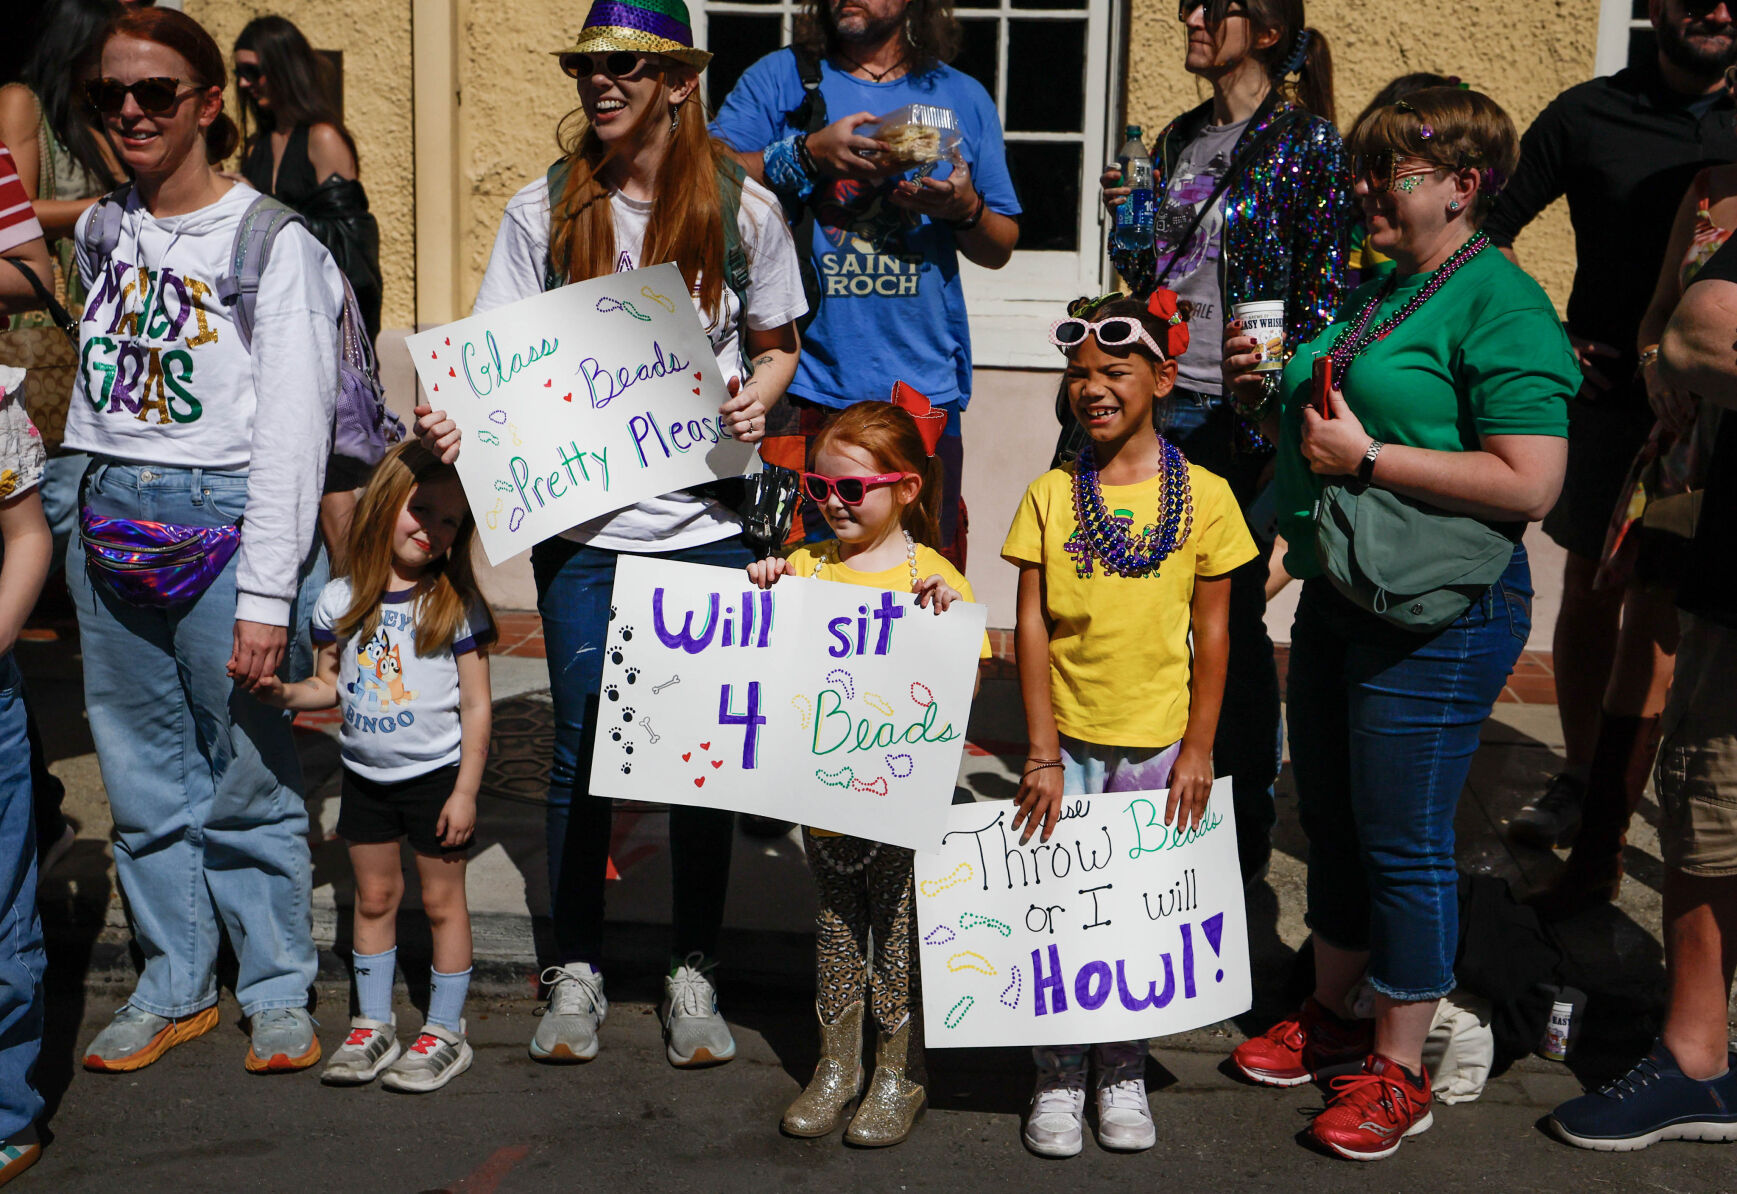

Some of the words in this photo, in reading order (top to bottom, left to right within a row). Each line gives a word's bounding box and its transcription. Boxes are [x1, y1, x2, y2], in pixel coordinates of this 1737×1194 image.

[83, 260, 218, 349] MARDI
[826, 275, 919, 295] ROCH
[81, 336, 203, 424] GRAS
[462, 330, 559, 399] Glass
[576, 341, 689, 409] Beads
[509, 441, 609, 512] Pretty
[627, 411, 732, 468] Please
[652, 587, 775, 654] Will
[827, 591, 906, 658] sit
[346, 705, 414, 733] BINGO
[718, 681, 766, 769] 4
[812, 689, 961, 755] Beads
[942, 811, 1112, 890] Throw
[1122, 797, 1224, 859] Beads
[1025, 903, 1066, 934] or
[1078, 884, 1113, 930] I
[1143, 869, 1197, 920] will
